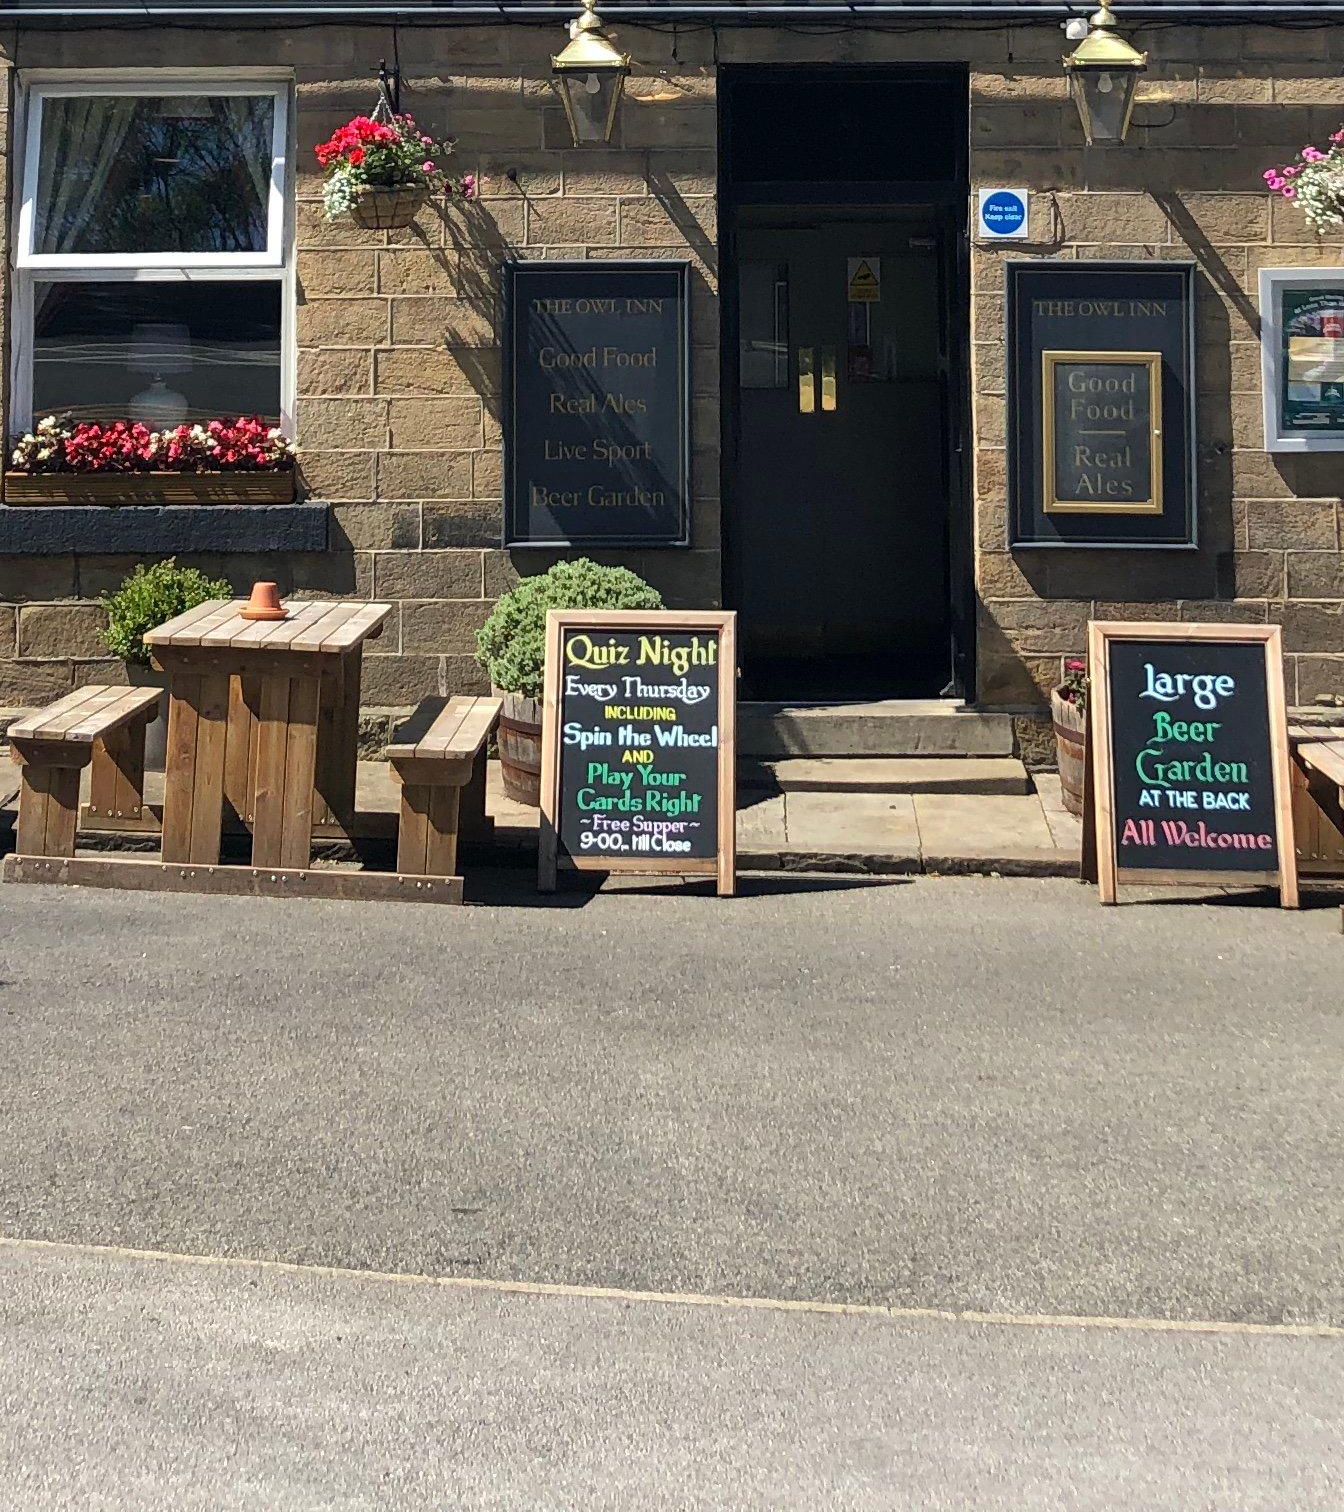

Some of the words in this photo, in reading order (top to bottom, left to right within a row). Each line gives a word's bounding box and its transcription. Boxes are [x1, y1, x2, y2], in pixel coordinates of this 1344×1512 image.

[533, 299, 572, 315] THE
[575, 299, 619, 315] OWL
[626, 299, 664, 315] INN
[1034, 301, 1074, 316] THE
[1077, 301, 1127, 317] OWL
[1128, 301, 1167, 317] INN
[539, 347, 597, 368] Good
[603, 347, 657, 367] Food
[1067, 371, 1136, 394] Good
[550, 393, 596, 413] Real
[603, 392, 647, 413] Ales
[1069, 399, 1135, 421] Food
[543, 440, 587, 460] Live
[592, 440, 652, 468] Sport
[1073, 445, 1131, 468] Real
[531, 486, 583, 506] Beer
[588, 485, 665, 507] Garden
[1074, 473, 1134, 496] Ales
[565, 635, 631, 670] Quiz
[636, 636, 717, 676] Night
[565, 675, 617, 701] Every
[621, 676, 711, 704] Thursday
[1138, 663, 1235, 710] Large
[604, 705, 677, 721] INCLUDING
[563, 722, 612, 750] Spin
[617, 724, 652, 746] the
[653, 725, 718, 747] Wheel
[1145, 711, 1223, 745] Beer
[621, 749, 654, 764] AND
[1135, 748, 1249, 787] Garden
[587, 763, 634, 790] Play
[637, 764, 687, 786] Your
[576, 787, 648, 812] Cards
[646, 790, 702, 817] Right
[1138, 789, 1162, 808] AT
[1166, 790, 1198, 809] THE
[1202, 791, 1252, 810] BACK
[632, 834, 650, 851] till
[651, 834, 692, 852] Close
[1121, 818, 1157, 846] All
[1160, 820, 1273, 850] Welcome
